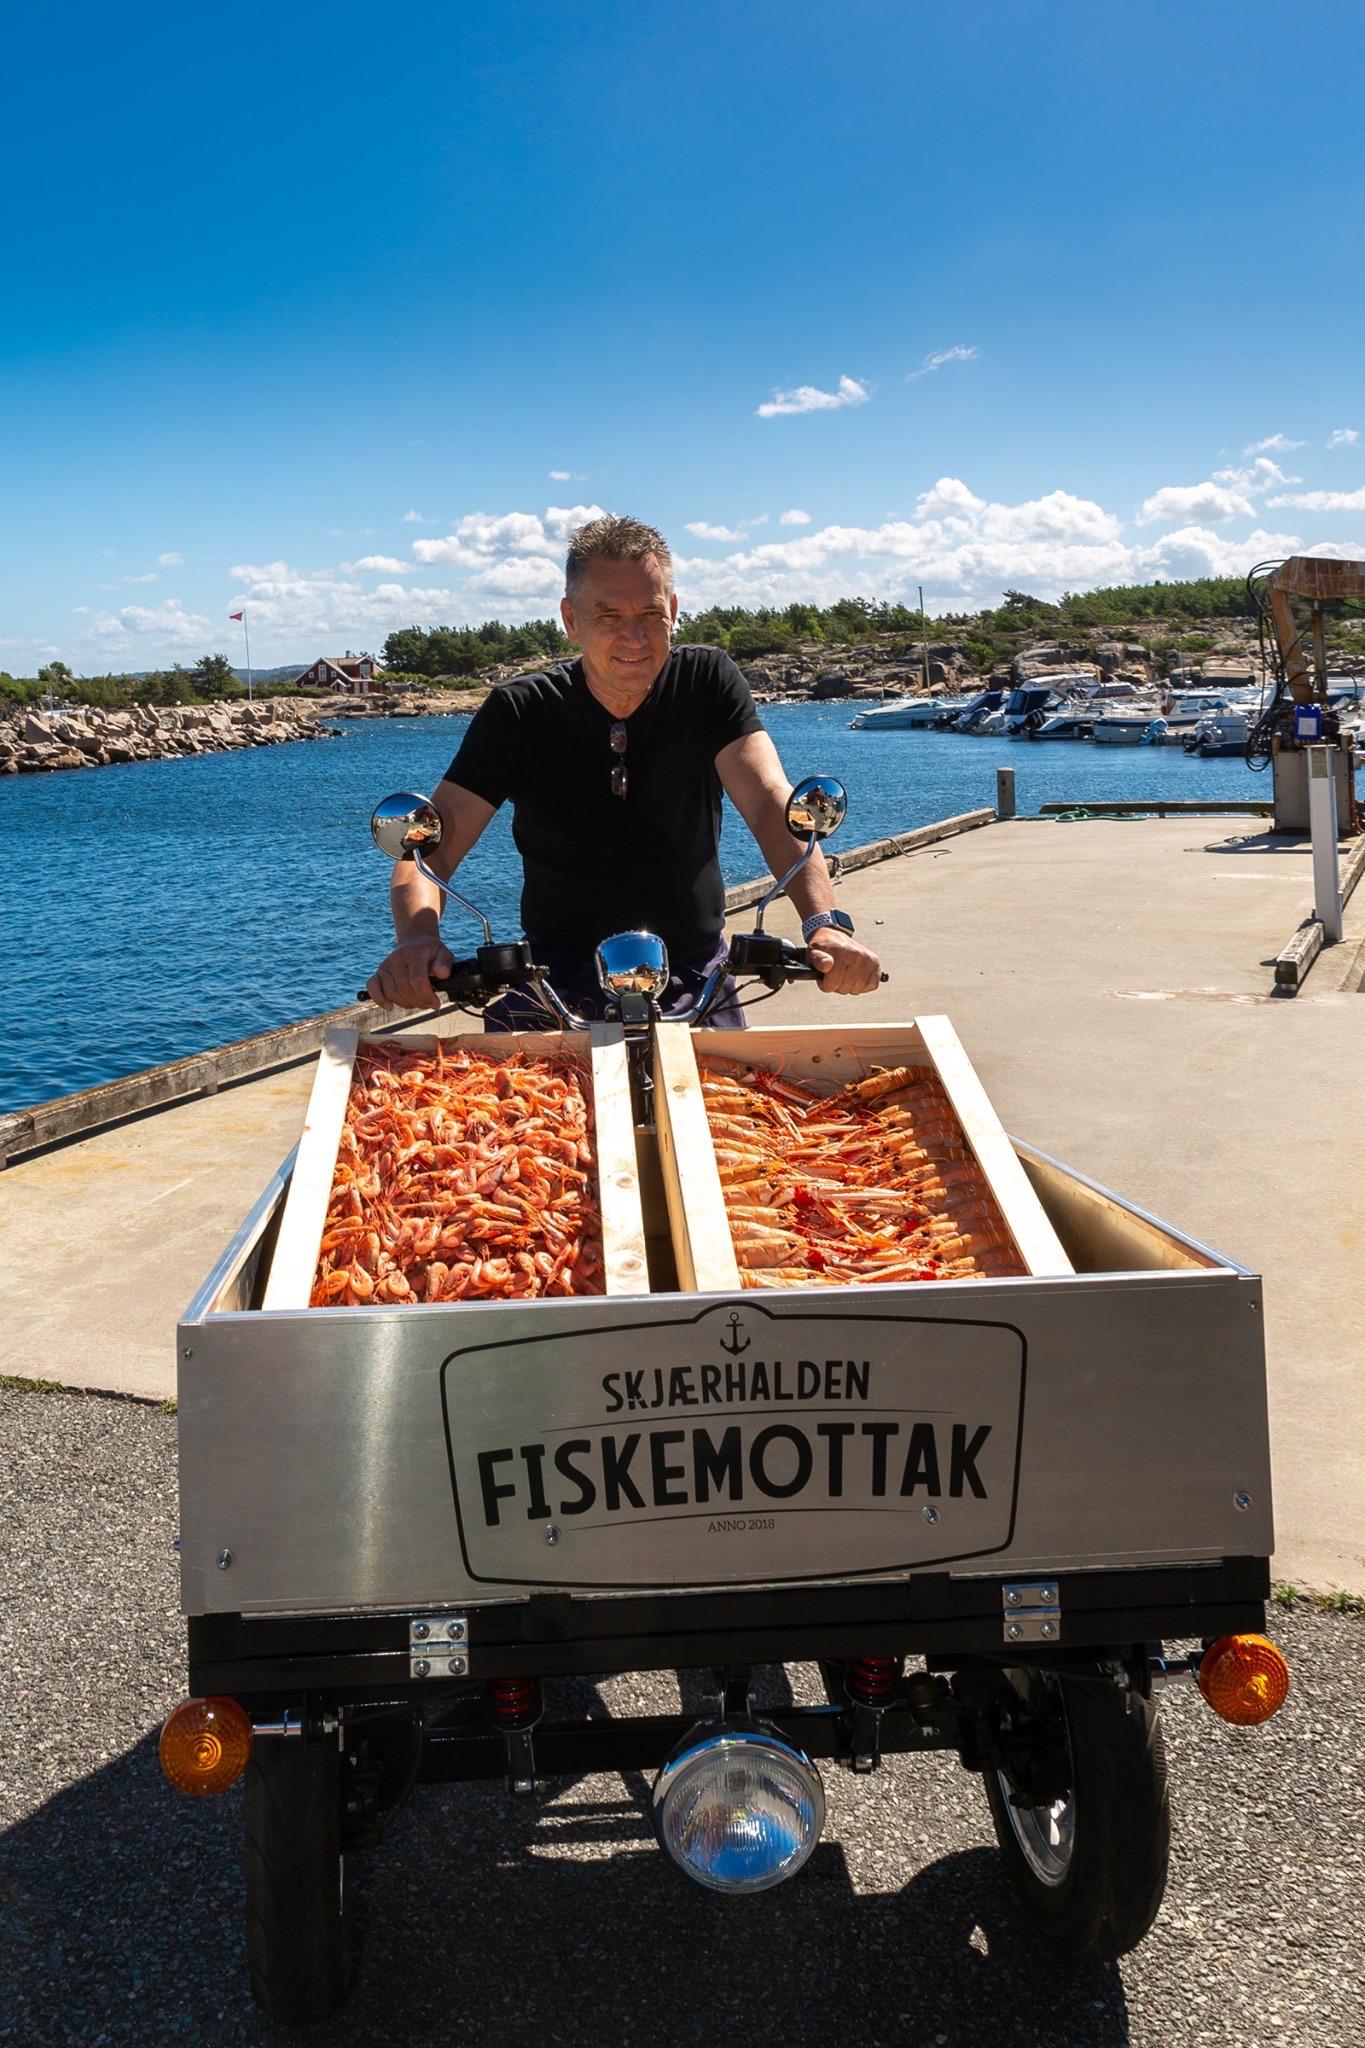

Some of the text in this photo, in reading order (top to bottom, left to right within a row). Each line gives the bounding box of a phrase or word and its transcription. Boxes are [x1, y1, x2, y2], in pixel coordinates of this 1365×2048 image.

[602, 1360, 870, 1412] SKJÆRHALDEN
[477, 1423, 992, 1526] FISKEMOTTAK
[708, 1518, 775, 1532] ANNO 2018
